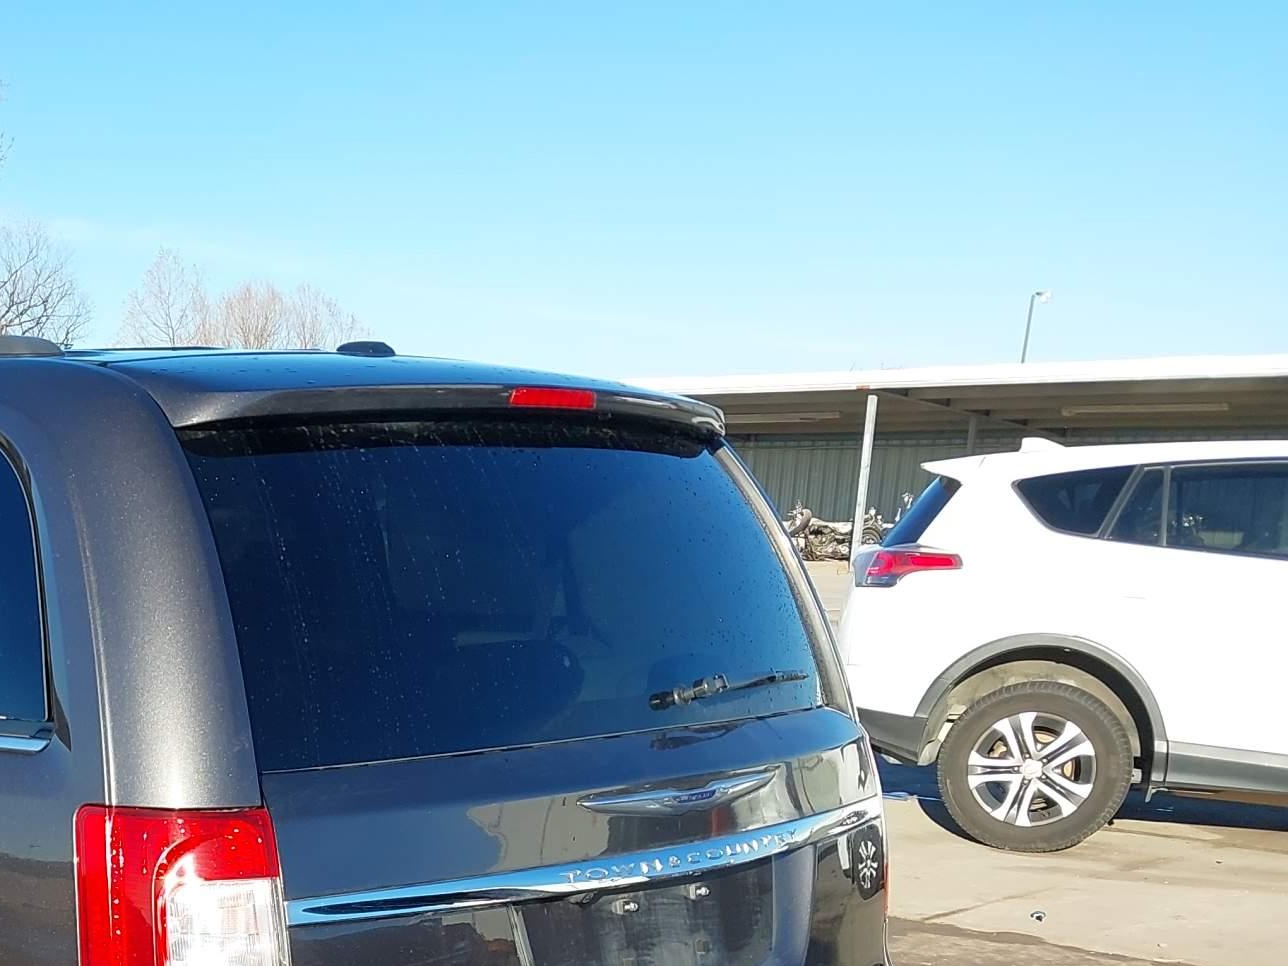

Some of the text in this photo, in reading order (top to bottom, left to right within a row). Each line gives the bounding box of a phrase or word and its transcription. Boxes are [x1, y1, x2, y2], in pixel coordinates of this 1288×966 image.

[560, 828, 797, 884] TOWN & COUNTRY
